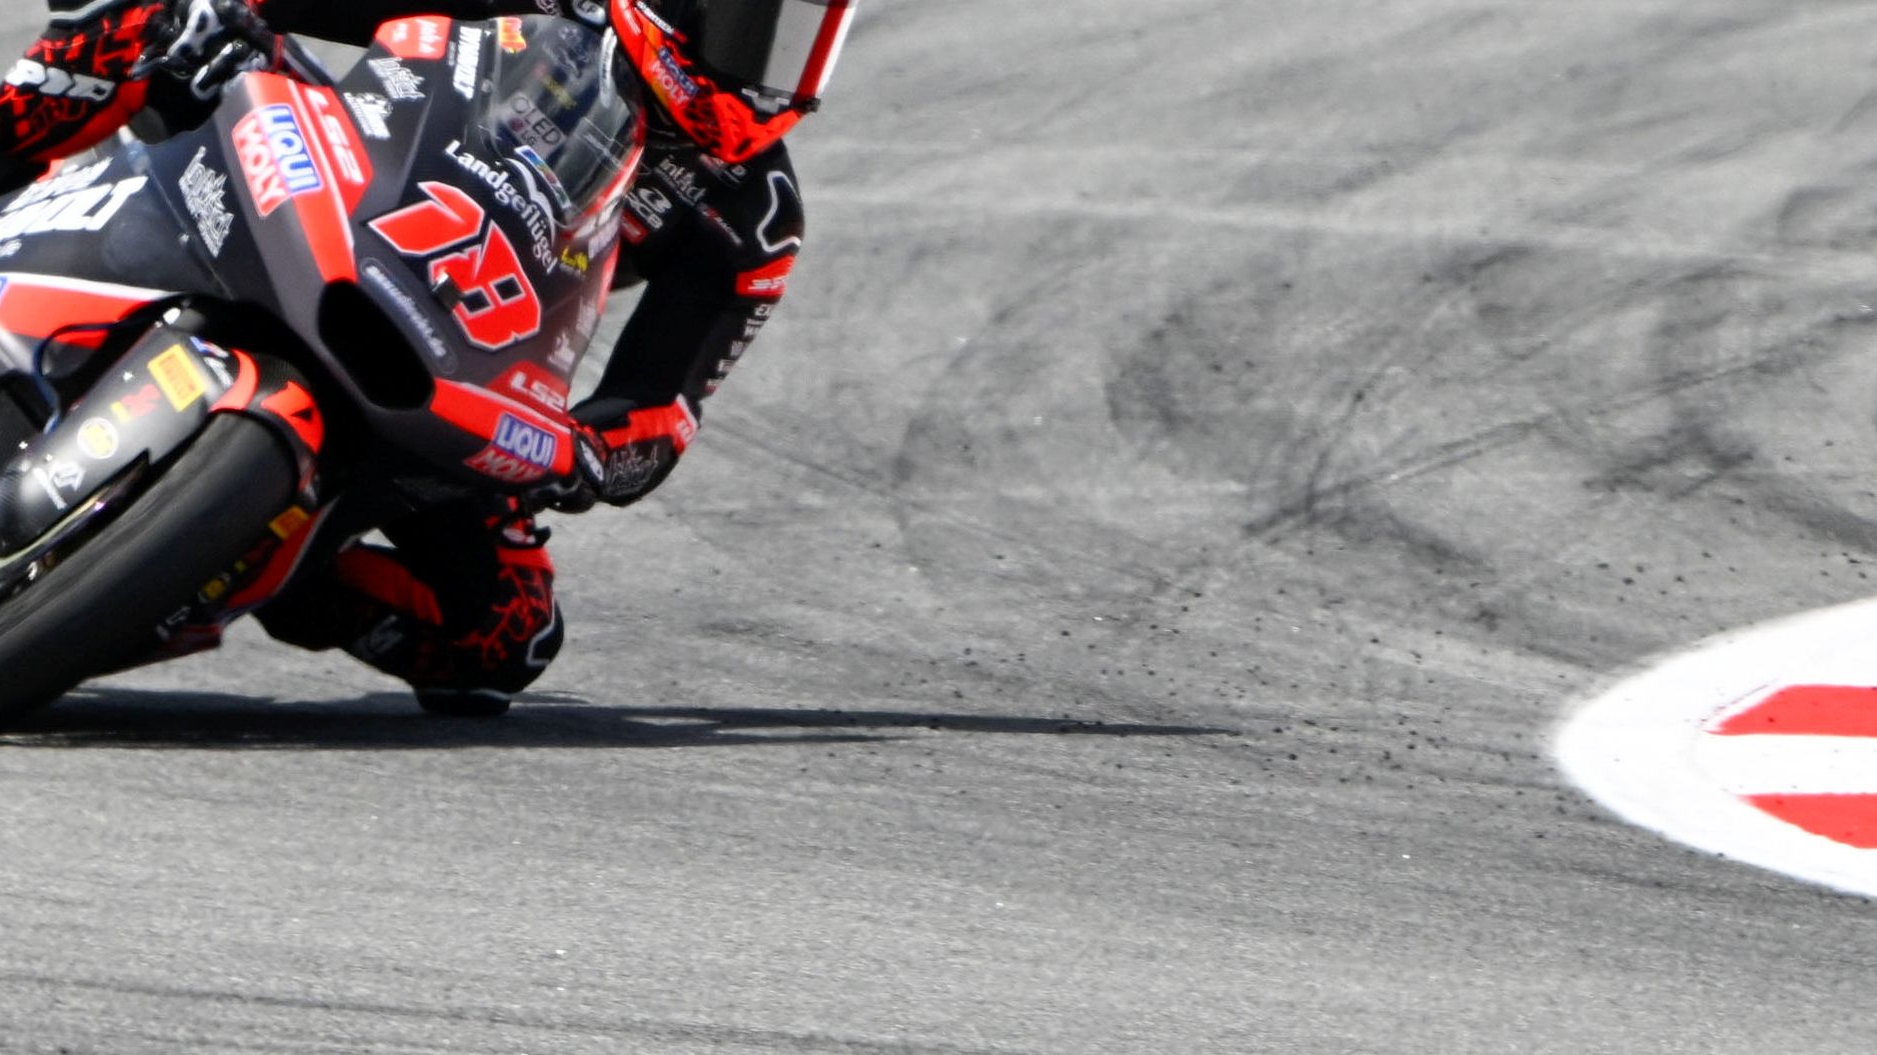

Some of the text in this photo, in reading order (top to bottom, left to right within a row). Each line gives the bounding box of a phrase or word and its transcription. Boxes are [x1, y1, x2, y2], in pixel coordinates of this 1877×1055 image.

[236, 117, 287, 204] MOLY
[259, 105, 323, 193] LIQUI
[510, 93, 562, 145] OLED
[443, 139, 559, 276] Landgeflügel
[367, 180, 542, 350] 18
[509, 370, 567, 414] LS2
[495, 416, 555, 468] LIQUI
